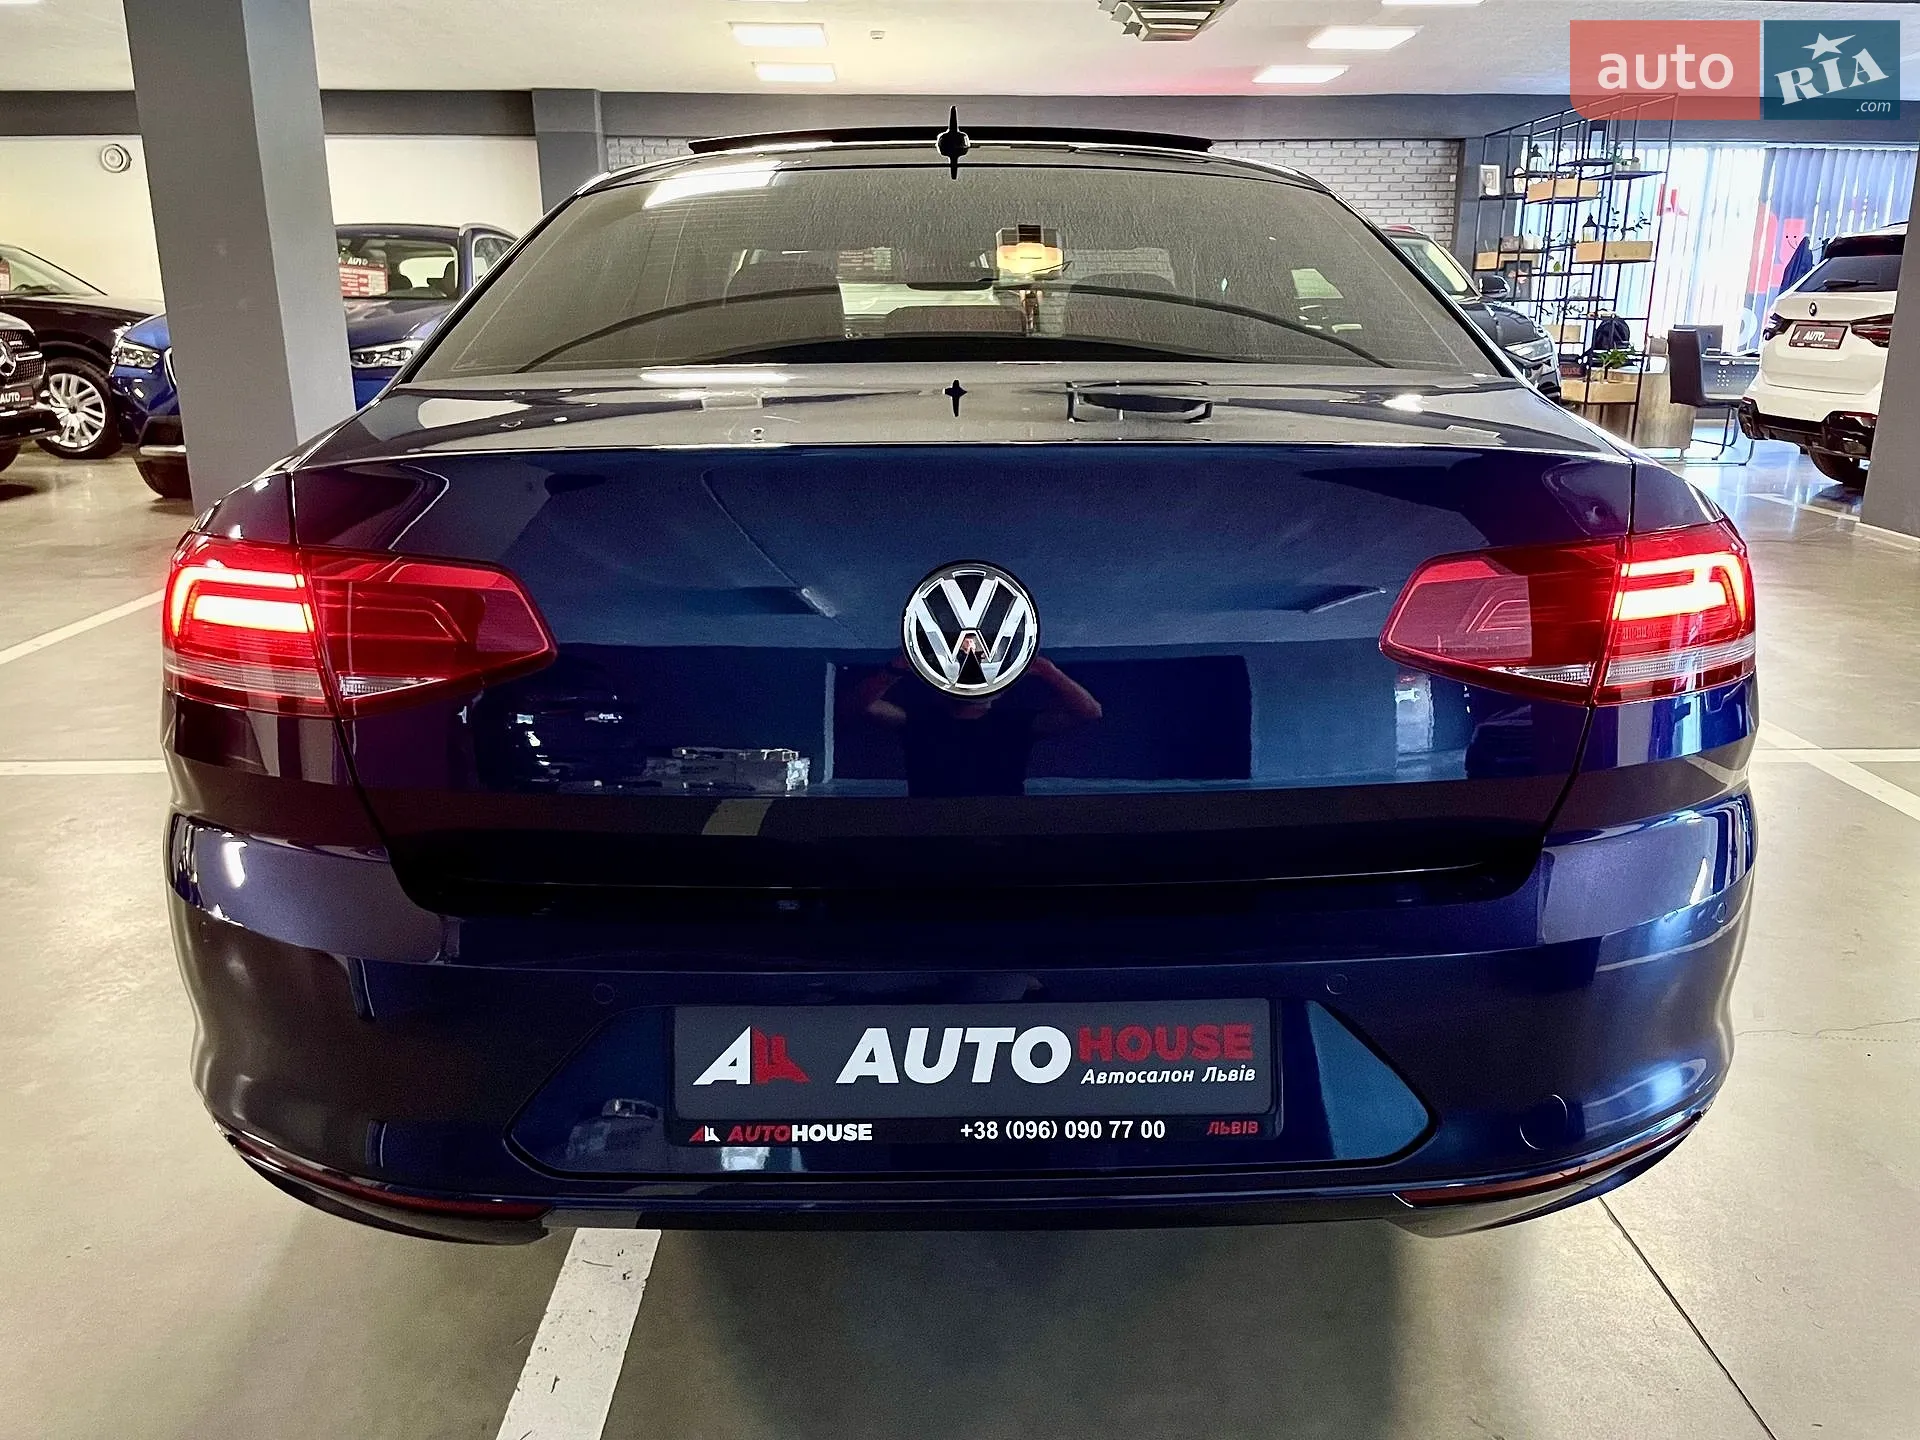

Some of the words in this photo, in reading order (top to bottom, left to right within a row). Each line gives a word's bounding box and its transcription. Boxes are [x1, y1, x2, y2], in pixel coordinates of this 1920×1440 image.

[1080, 1068, 1195, 1085] Автосалон
[1201, 1065, 1256, 1083] Львів
[960, 1121, 998, 1139] +38
[1005, 1121, 1058, 1140] (096)
[1064, 1120, 1102, 1139] 090
[1108, 1120, 1134, 1138] 77
[1140, 1120, 1166, 1139] 00
